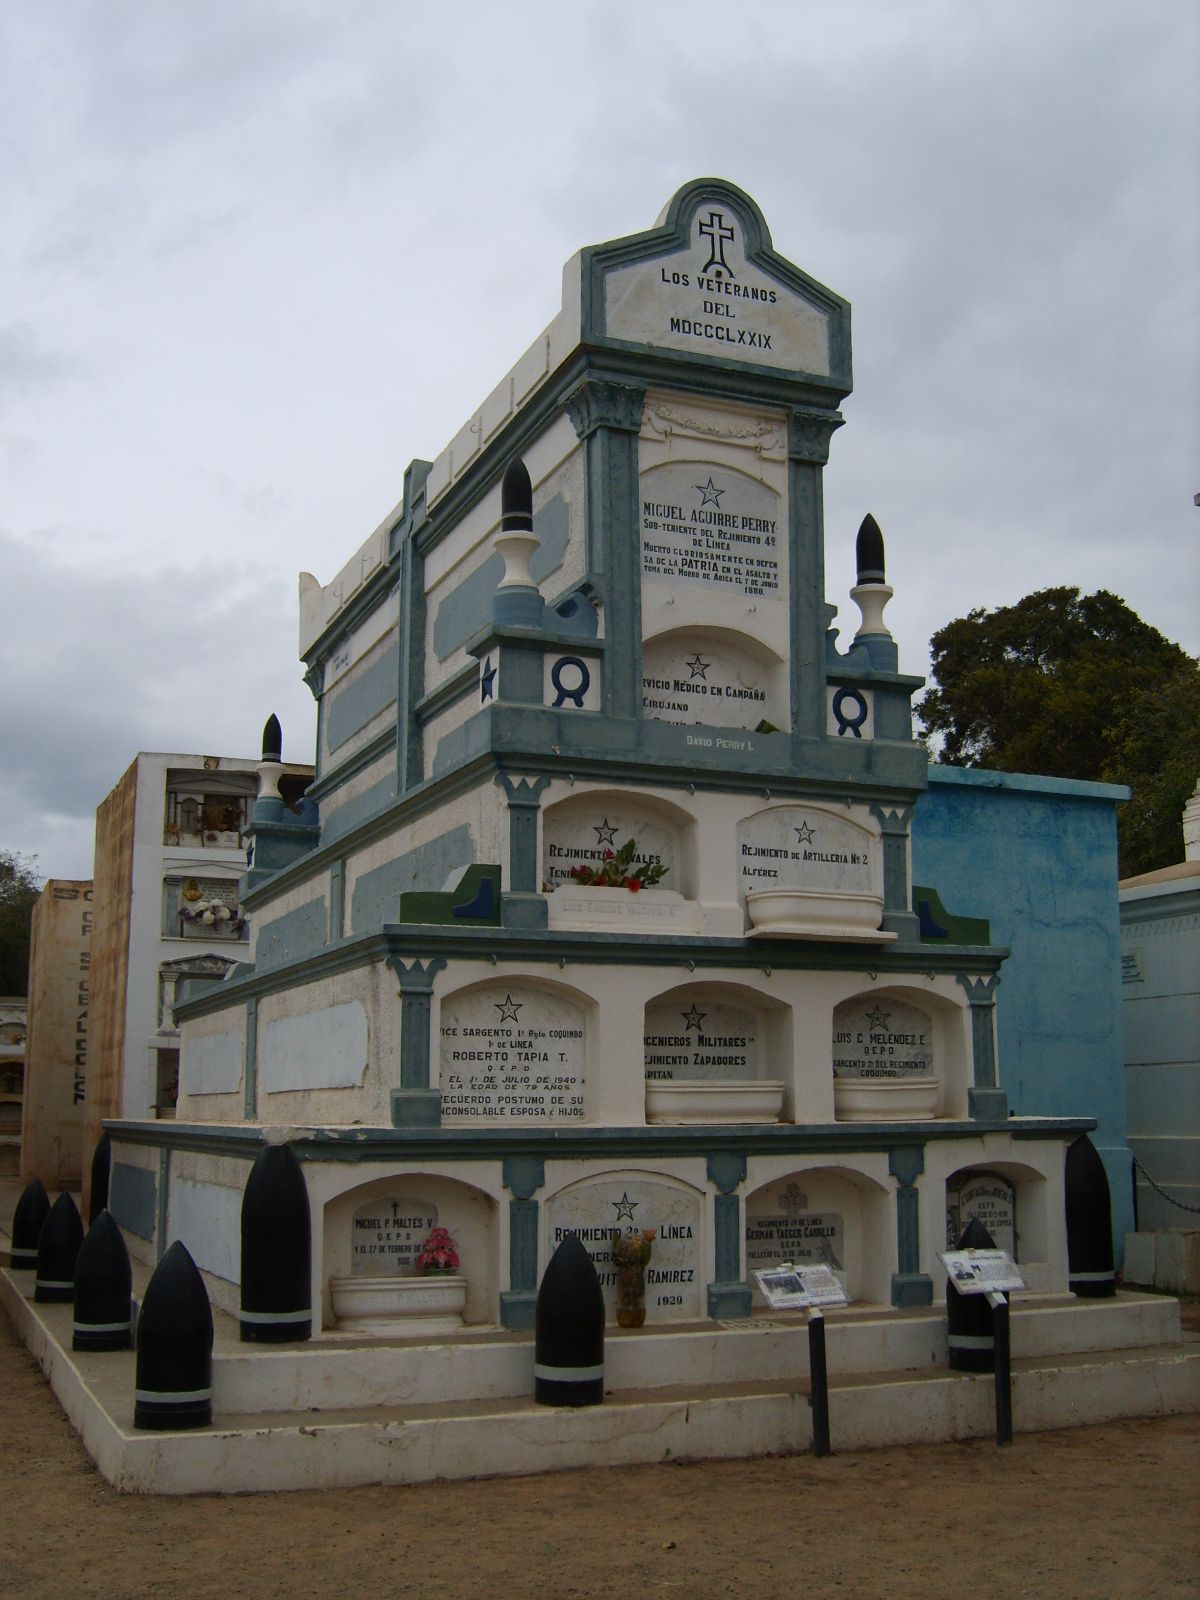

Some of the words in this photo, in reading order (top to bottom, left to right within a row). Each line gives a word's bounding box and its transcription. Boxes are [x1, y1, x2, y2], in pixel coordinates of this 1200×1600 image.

[661, 268, 689, 286] LOS
[697, 277, 776, 303] VETERANOS
[704, 301, 735, 318] DEL
[670, 318, 772, 349] MDCCCLXXIX
[644, 503, 685, 520] MIGUEL
[691, 510, 738, 528] AGUIRRE
[742, 517, 776, 533] PERRY
[644, 519, 697, 535] SUB-TENIENTE
[701, 529, 714, 538] DEL
[718, 530, 760, 544] REJIMIENTO
[706, 538, 730, 550] LINEA
[644, 542, 670, 554] MUERTO
[674, 548, 743, 564] GLORIOSAMENTE
[746, 558, 753, 566] EN
[682, 558, 718, 572] PATRIA
[734, 567, 742, 575] EL
[746, 570, 770, 579] ASALTO
[664, 567, 675, 575] DEL
[678, 568, 699, 578] MORRO
[714, 573, 732, 582] ARICA
[761, 580, 778, 588] JUNIO
[643, 679, 670, 690] RVICIO
[711, 687, 722, 696] EN
[726, 687, 765, 701] CAMPAÑA
[643, 698, 688, 711] CIRUJANO
[687, 736, 712, 746] DAVID
[717, 738, 745, 750] PERRY
[742, 844, 788, 859] REJIMIENTO
[803, 850, 848, 864] ARTILLERIA
[863, 855, 867, 865] 2
[550, 1030, 582, 1039] COQUIMBO
[644, 1036, 691, 1046] GENIEROS
[870, 1034, 915, 1045] MELENDEZ
[453, 1052, 508, 1061] ROBERTO
[517, 1053, 548, 1061] TAPIA
[645, 1056, 688, 1065] JIMIENTO
[694, 1054, 746, 1065] ZAPADORES
[645, 1071, 672, 1079] PITAN
[498, 1096, 544, 1104] POSTUMO
[551, 1096, 563, 1104] DE
[571, 1096, 583, 1104] SU
[441, 1107, 505, 1115] NCONSOLABLE
[393, 1218, 423, 1228] MALTES
[804, 1227, 835, 1238] CARRILLO
[648, 1270, 693, 1284] RAMIREZ
[657, 1296, 682, 1306] 1929
